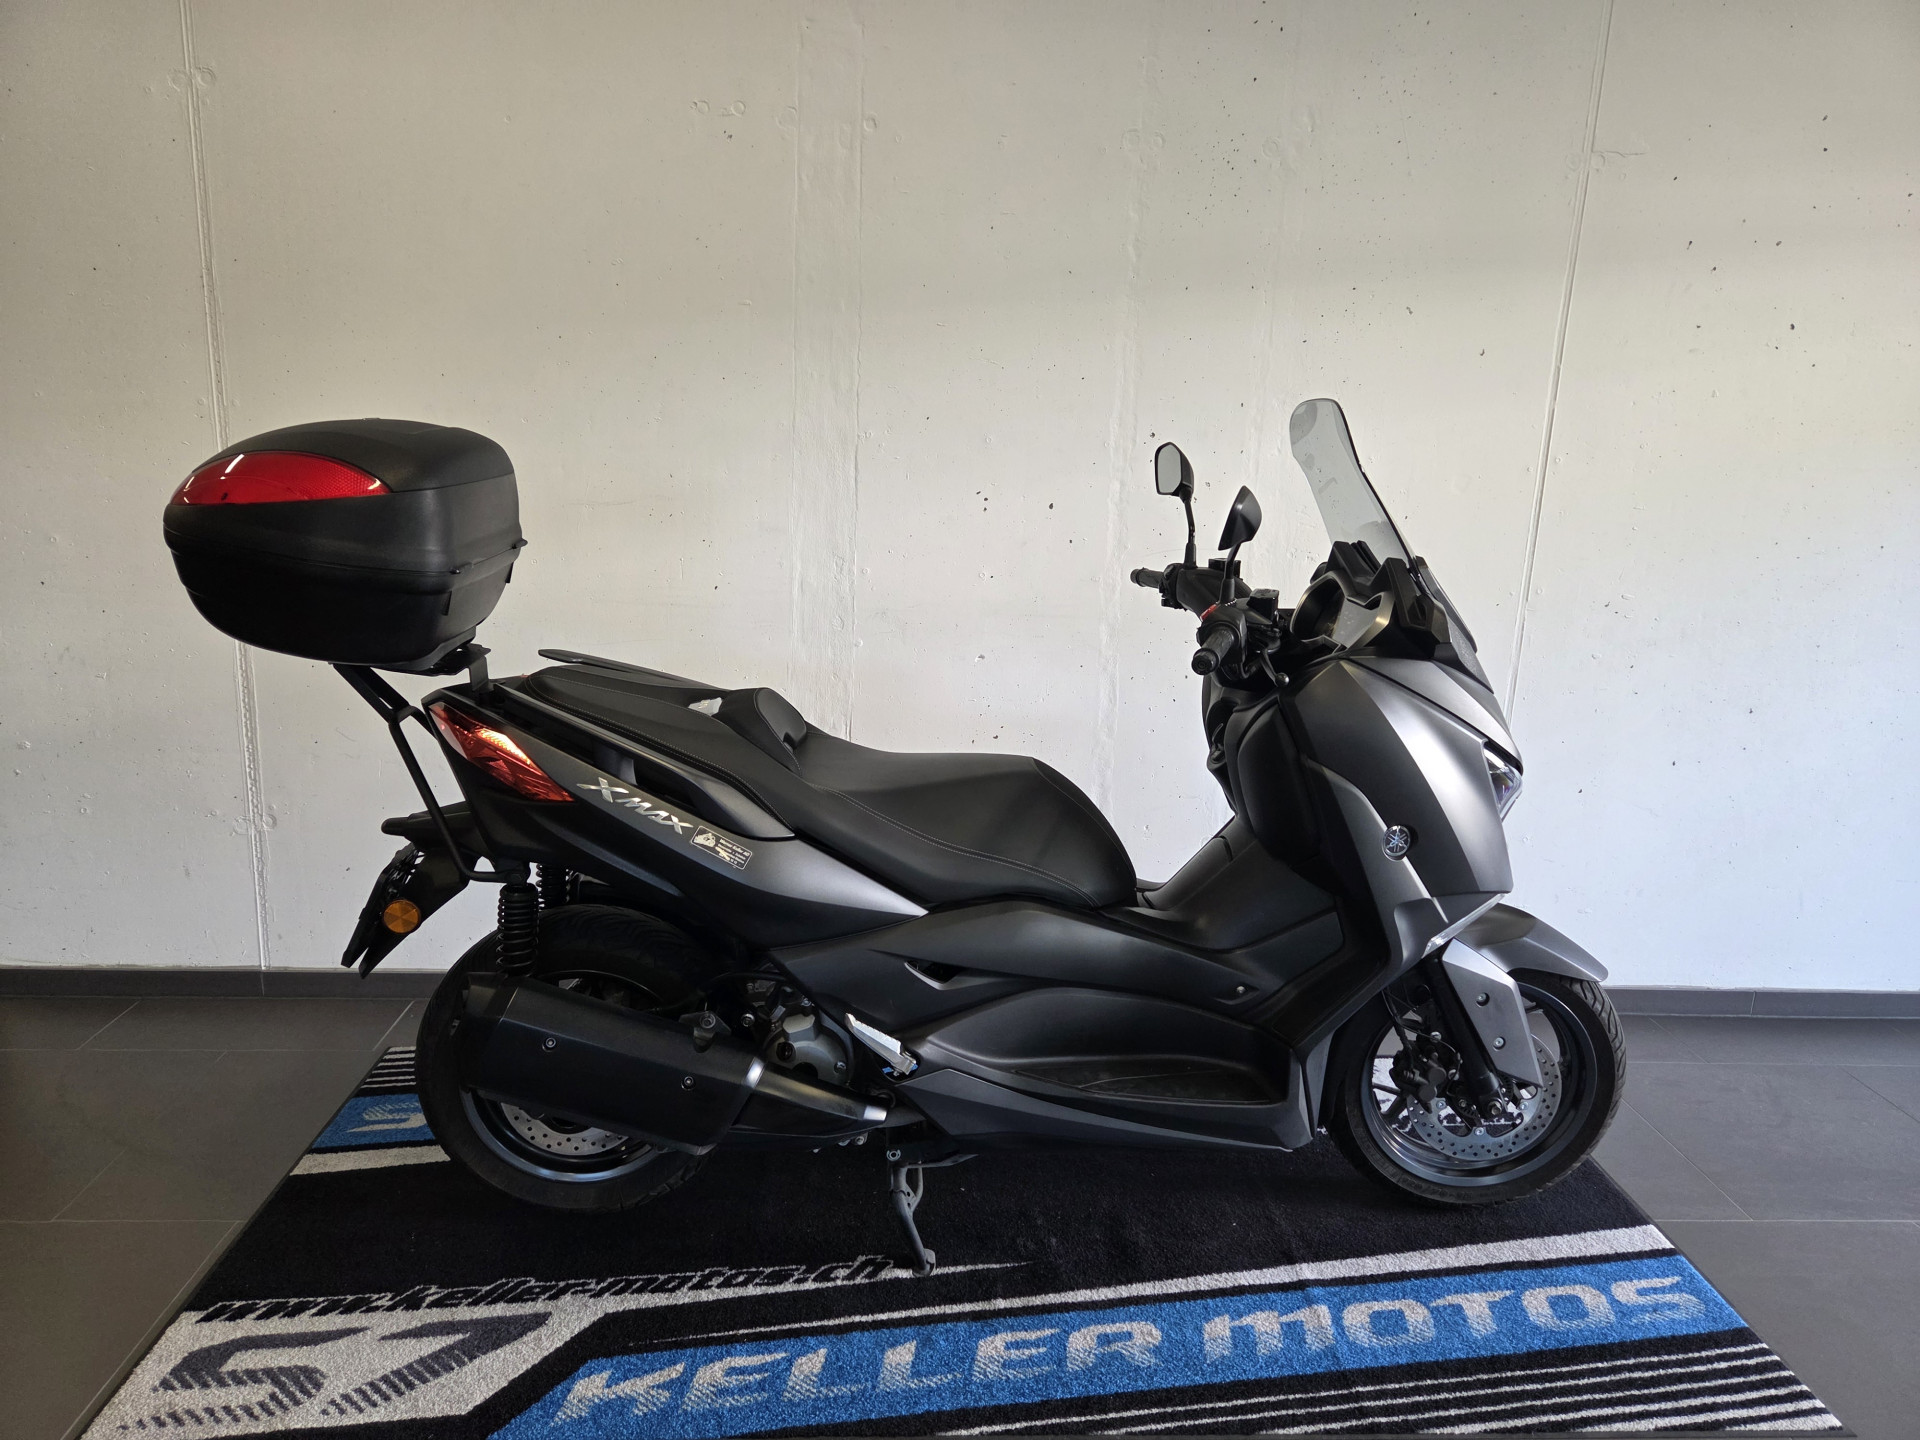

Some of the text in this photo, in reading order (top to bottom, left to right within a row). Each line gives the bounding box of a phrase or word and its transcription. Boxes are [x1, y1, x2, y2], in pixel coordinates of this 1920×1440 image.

[577, 777, 693, 834] XMAX
[196, 1255, 893, 1324] www.keller-motos.ch
[548, 1275, 1706, 1427] KELLER MOTOS
